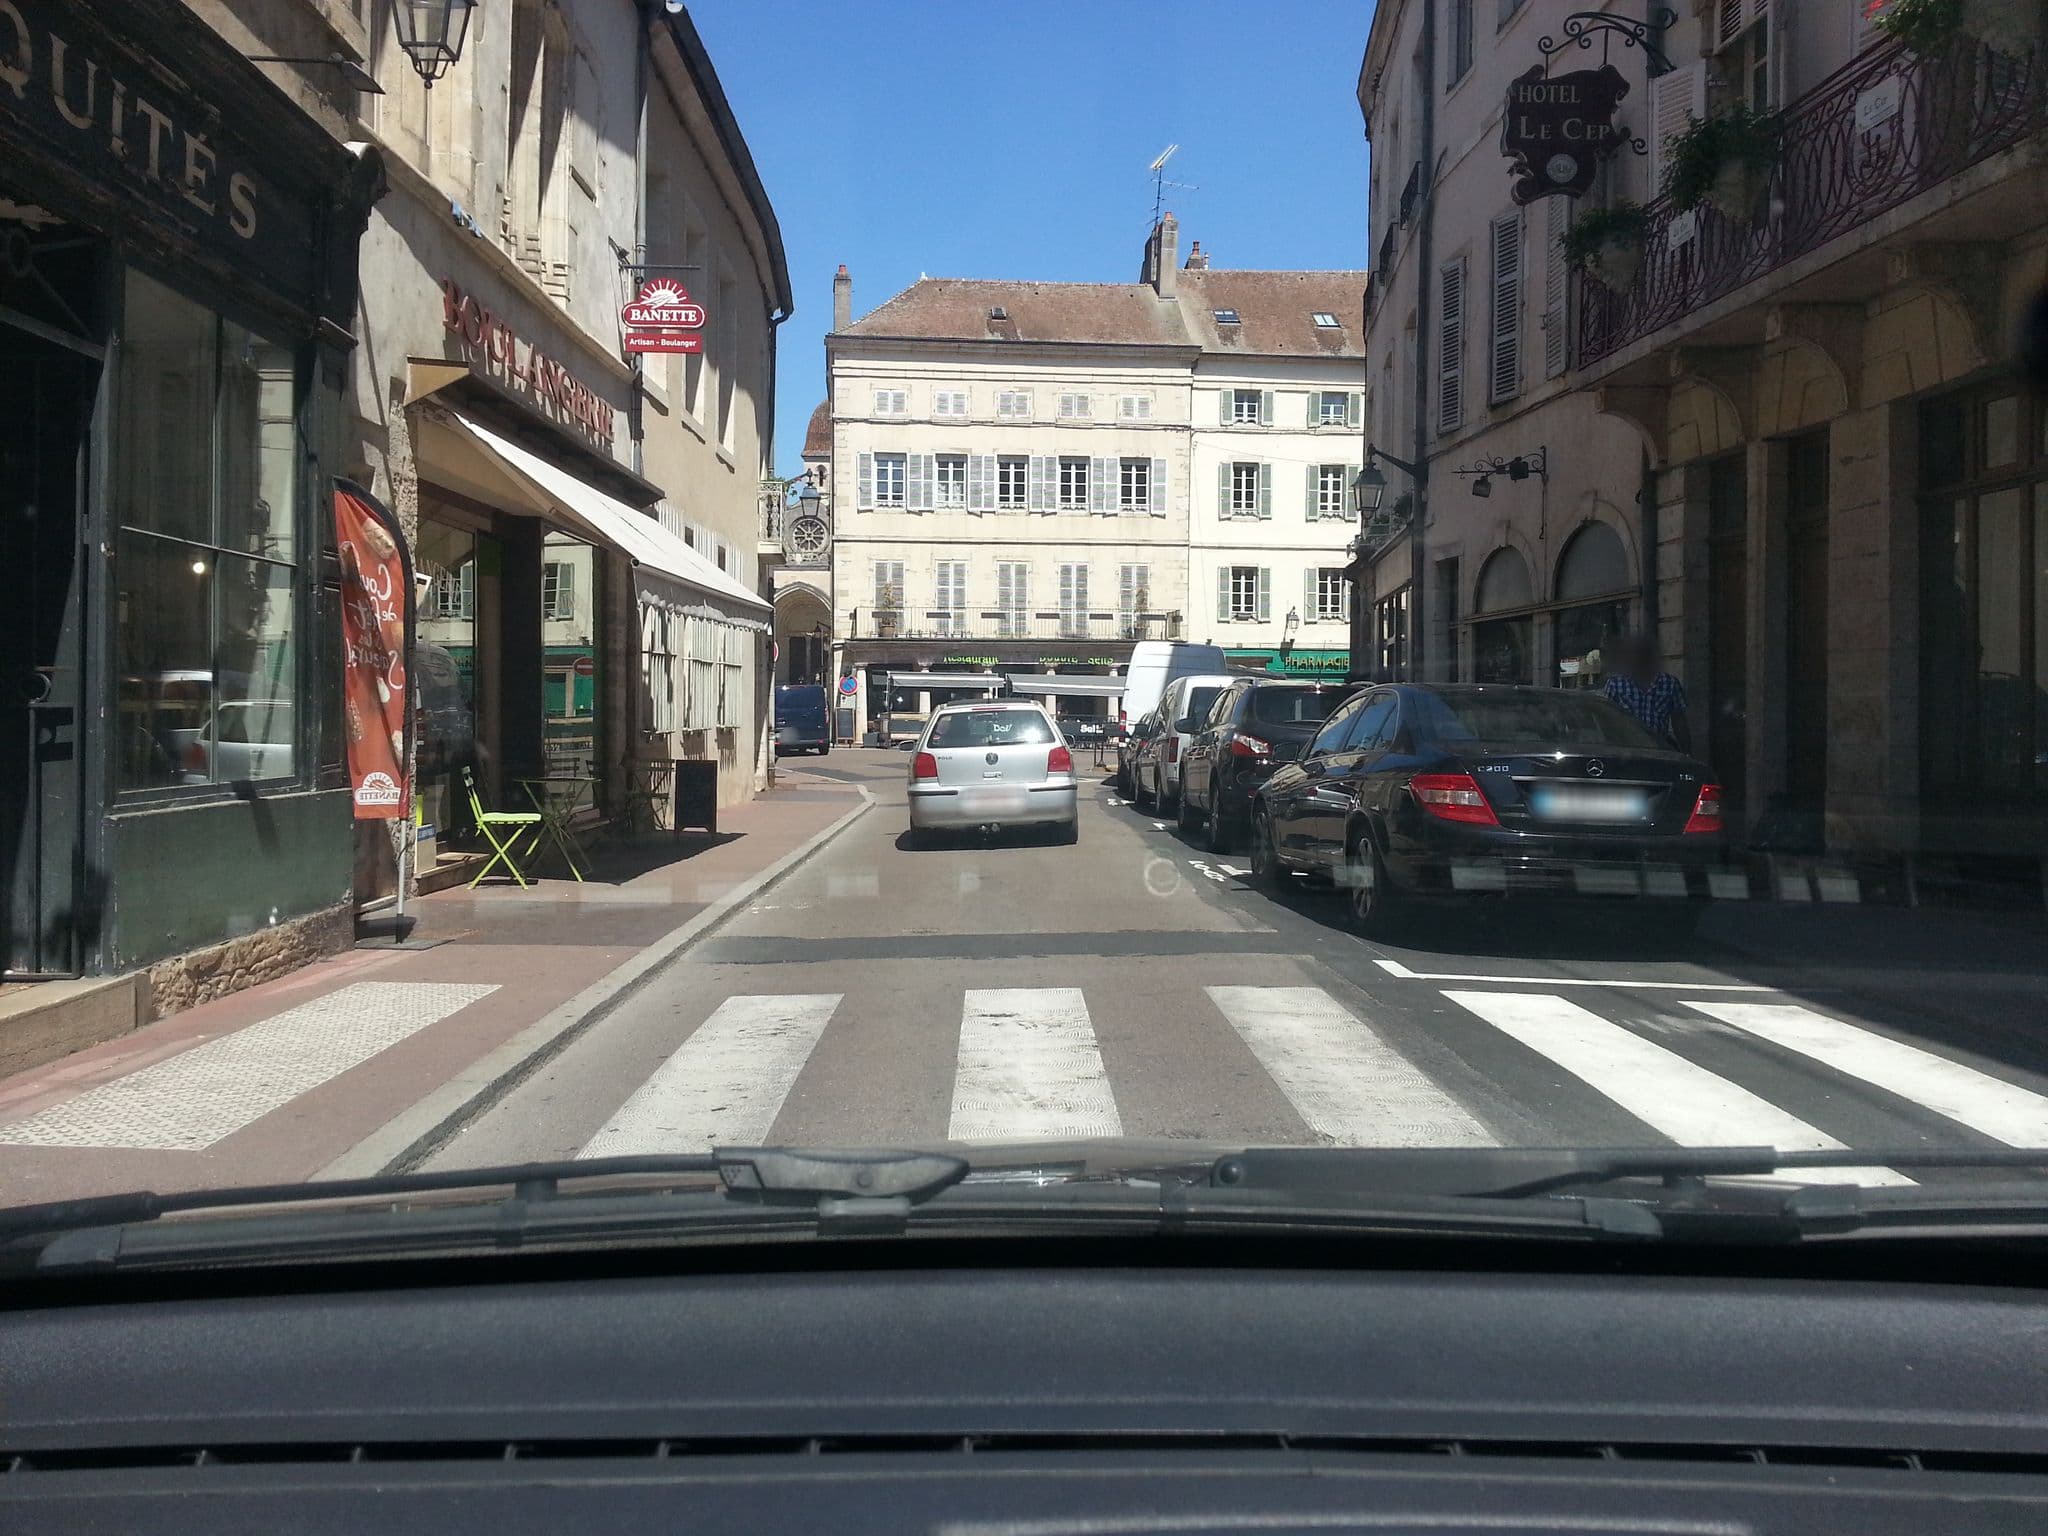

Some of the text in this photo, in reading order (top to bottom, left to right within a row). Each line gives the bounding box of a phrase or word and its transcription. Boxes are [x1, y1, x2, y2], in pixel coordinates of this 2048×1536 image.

[1519, 84, 1582, 103] HOTEL
[630, 308, 697, 322] BANETTE
[629, 337, 655, 346] Artisan
[660, 338, 697, 348] Boulanger
[441, 275, 615, 444] BOULANGERIE
[1285, 656, 1350, 670] PHARMACIE
